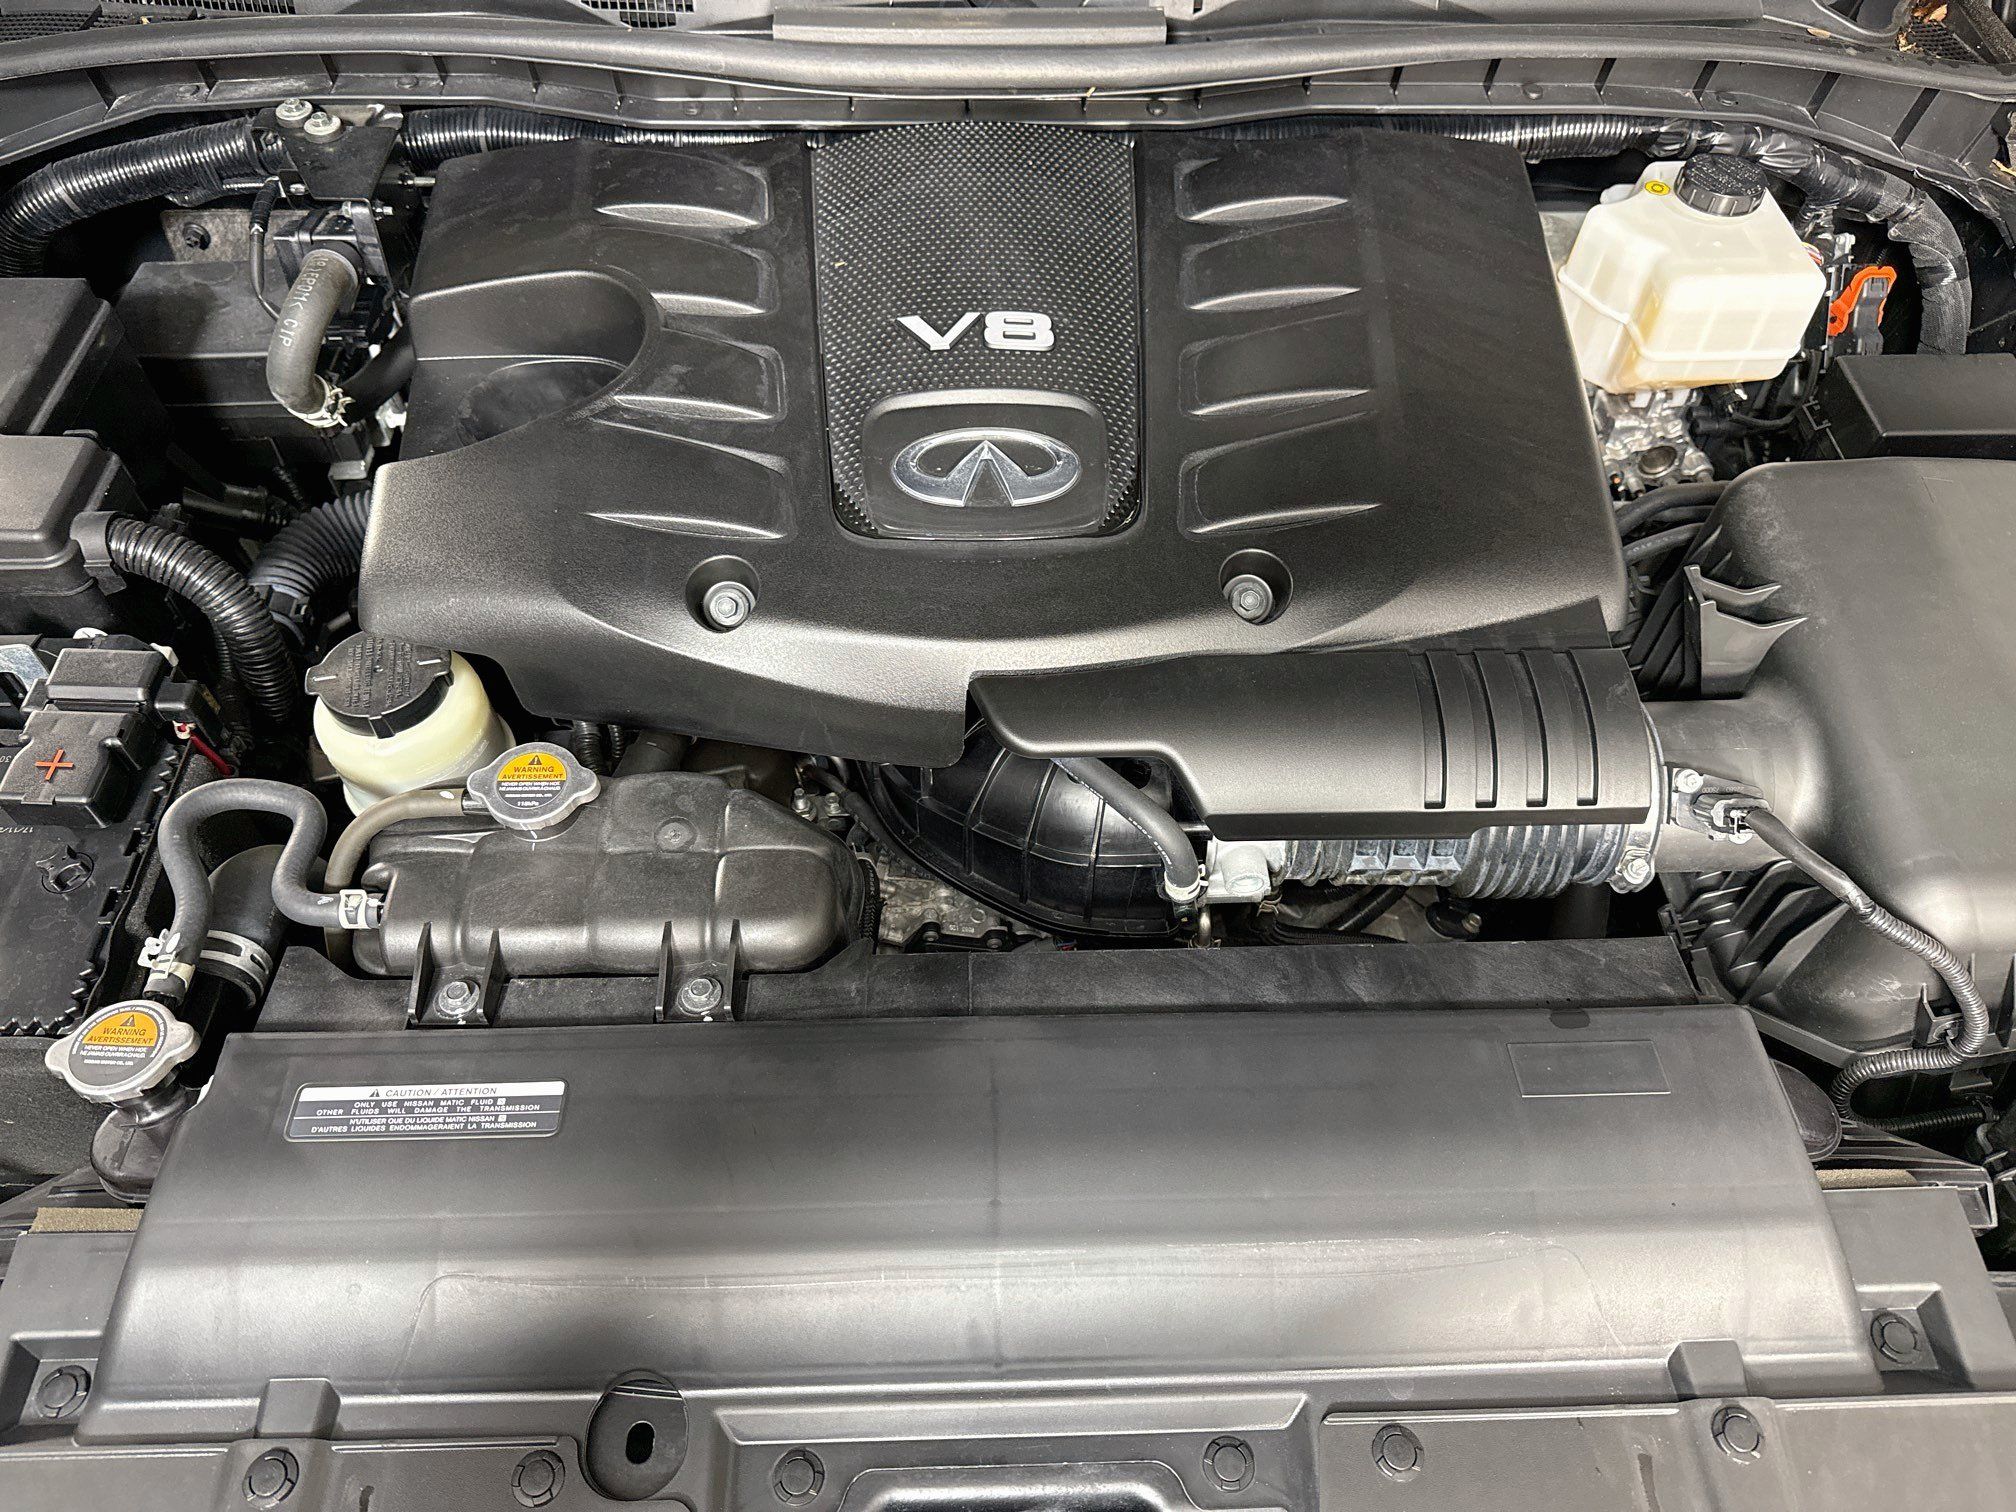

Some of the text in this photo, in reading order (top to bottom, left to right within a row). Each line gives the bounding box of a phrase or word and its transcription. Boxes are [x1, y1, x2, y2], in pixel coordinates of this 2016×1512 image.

[896, 310, 1056, 351] V8
[102, 1027, 147, 1036] WARNING
[87, 1036, 154, 1044] AVERTISSEMENT
[385, 1088, 431, 1098] CAUTION
[441, 1087, 498, 1096] ATTENTION
[414, 1106, 449, 1114] DAMAGE
[480, 1104, 541, 1112] TRANSMISSION
[311, 1125, 348, 1133] D'AUTRES
[389, 1123, 465, 1131] ENDOMMAGERAIENT
